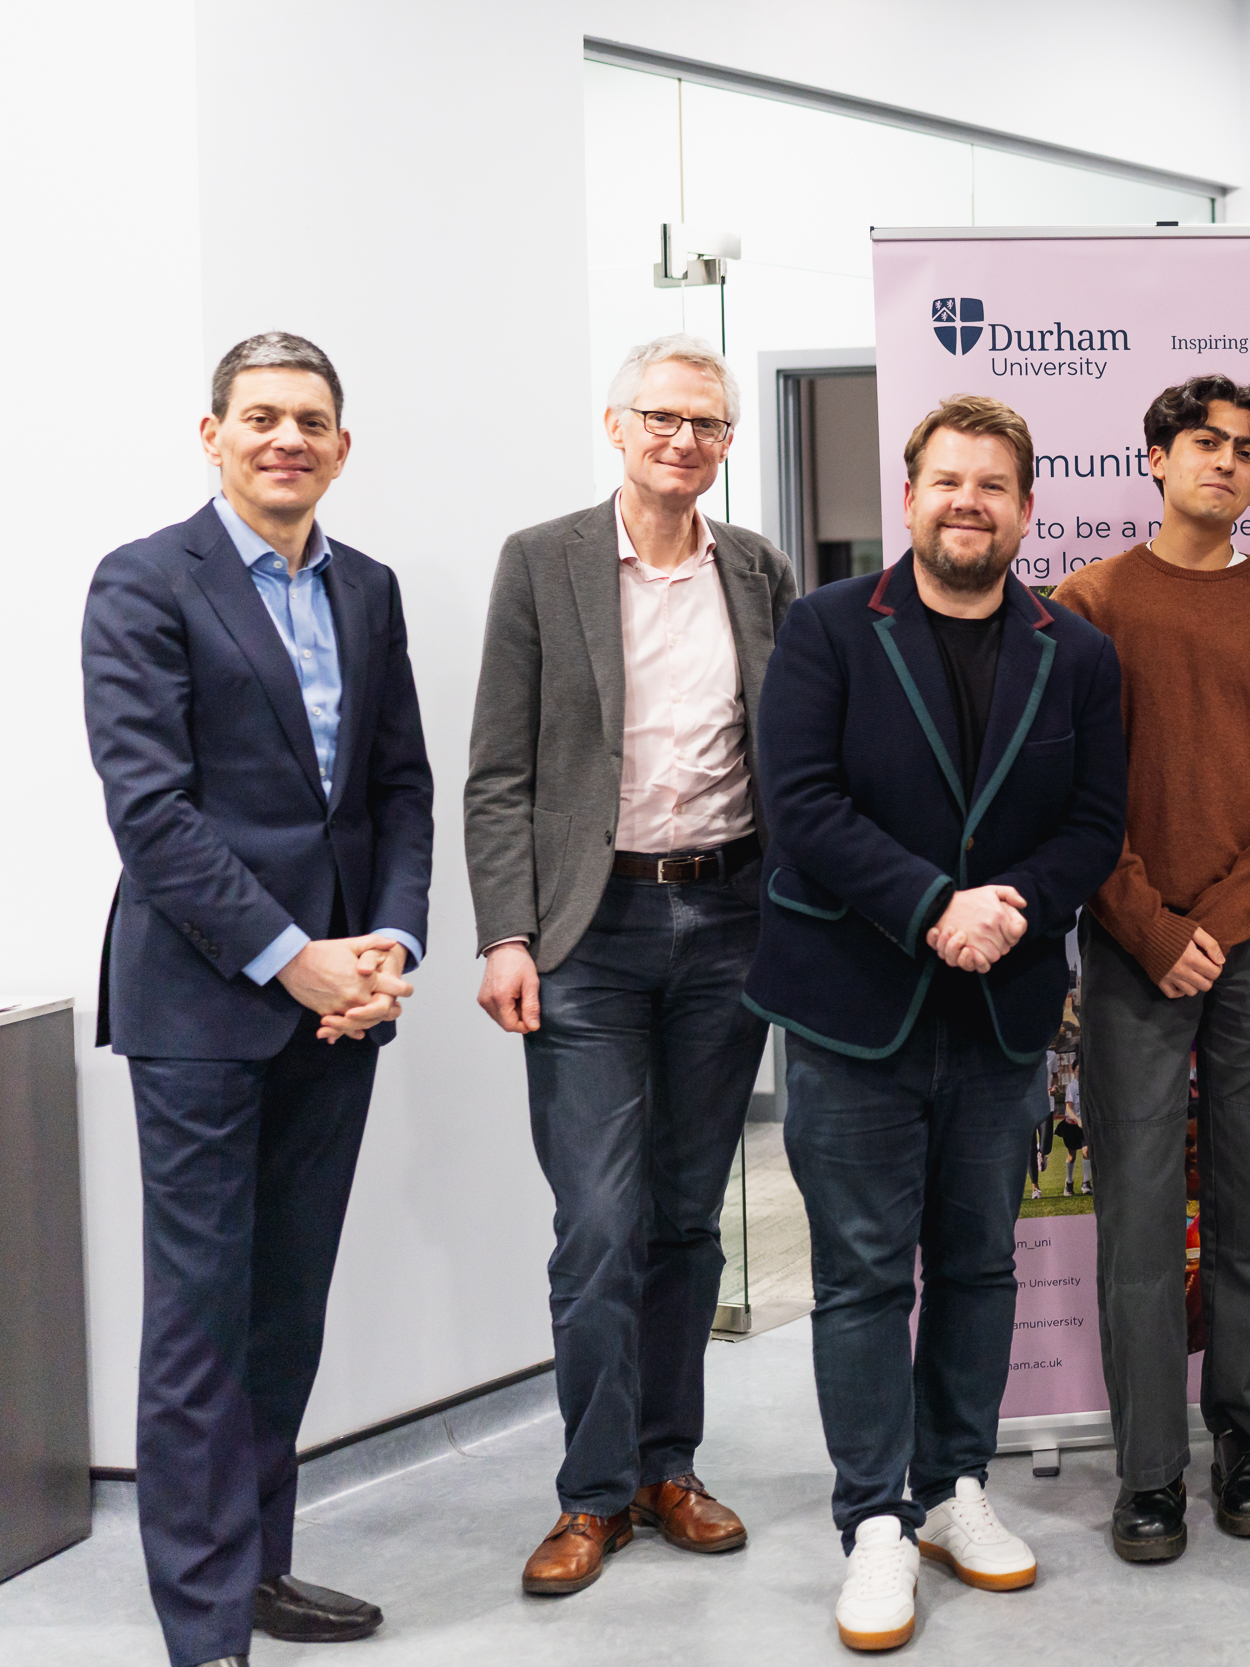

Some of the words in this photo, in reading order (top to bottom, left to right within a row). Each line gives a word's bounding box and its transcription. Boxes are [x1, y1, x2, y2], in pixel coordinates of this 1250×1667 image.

[987, 321, 1132, 352] Durham
[1170, 334, 1249, 354] Inspiring
[991, 356, 1108, 380] University
[1035, 446, 1149, 478] munit
[1035, 518, 1065, 539] to
[1076, 515, 1111, 539] be
[1121, 520, 1137, 538] a
[1016, 1237, 1052, 1250] m_uni
[1029, 1276, 1081, 1288] University
[1013, 1316, 1084, 1330] amuniversity
